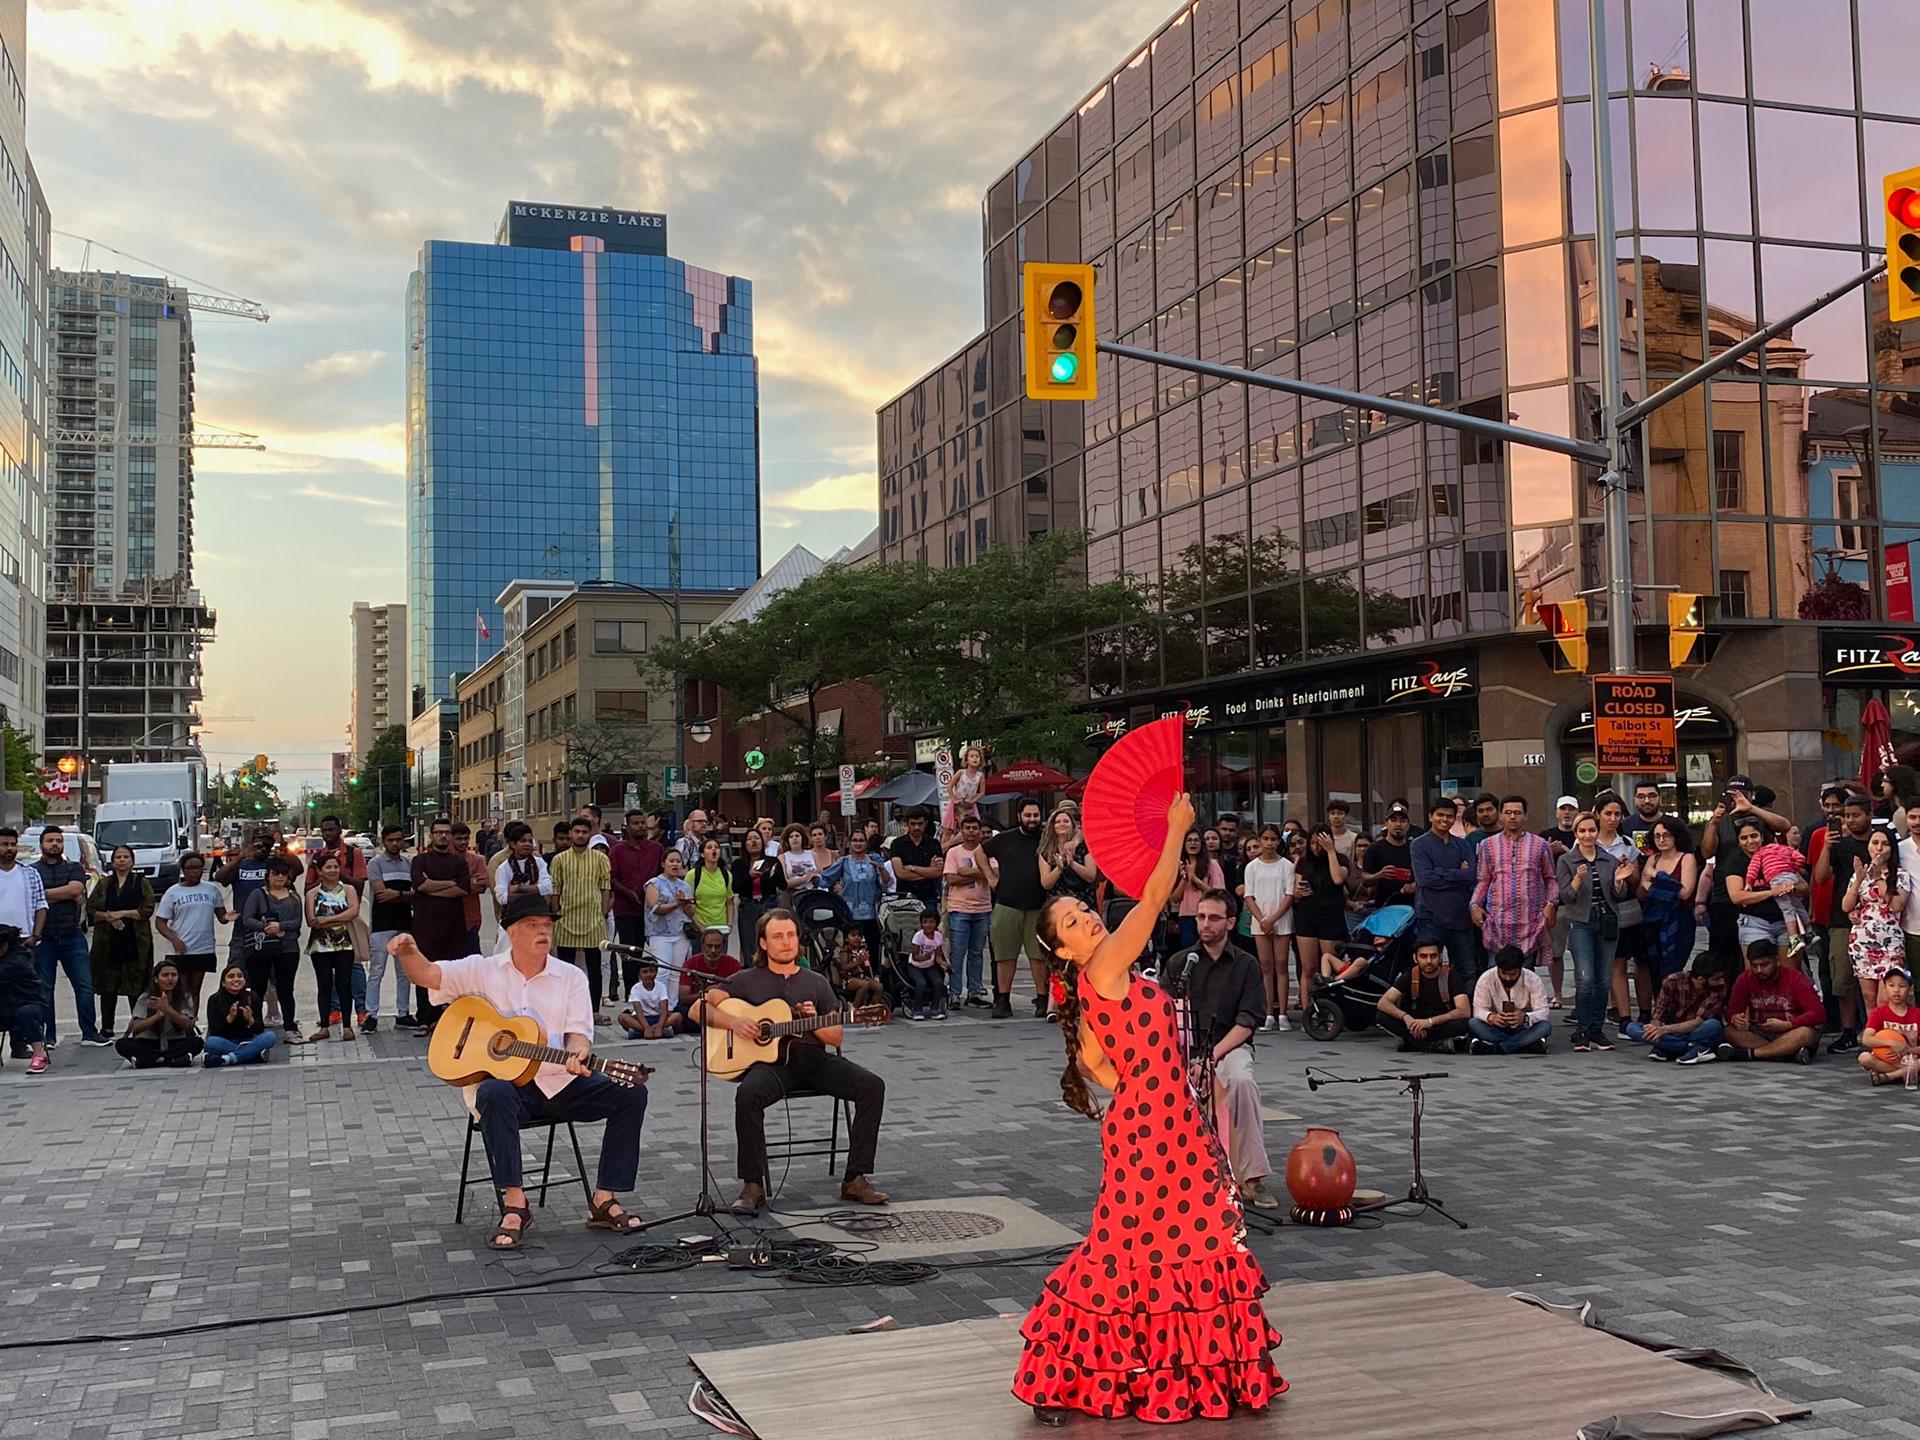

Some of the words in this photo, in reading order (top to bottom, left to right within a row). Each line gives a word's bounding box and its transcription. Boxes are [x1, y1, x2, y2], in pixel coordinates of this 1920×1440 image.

[618, 214, 662, 228] LAKE
[1837, 649, 1881, 664] FITZ
[1875, 635, 1920, 673] Ra
[1391, 676, 1418, 691] FITZ
[1416, 661, 1468, 697] Rays
[1611, 686, 1656, 698] ROAD
[1225, 701, 1247, 715] Food
[1255, 697, 1284, 711] Drinks
[1292, 684, 1365, 706] Entertainment
[1604, 702, 1665, 715] CLOSED
[1610, 720, 1646, 731] Talbot
[1650, 720, 1661, 731] St
[1608, 737, 1632, 745] Dundas
[1640, 738, 1662, 747] Carling
[1603, 745, 1619, 756] Night
[1620, 746, 1639, 754] Market
[1646, 747, 1661, 755] June
[1524, 755, 1545, 765] 110
[1602, 754, 1607, 762] &
[1607, 754, 1629, 763] Canada
[1629, 755, 1640, 764] Day
[1650, 755, 1663, 765] July
[1664, 756, 1669, 764] 2
